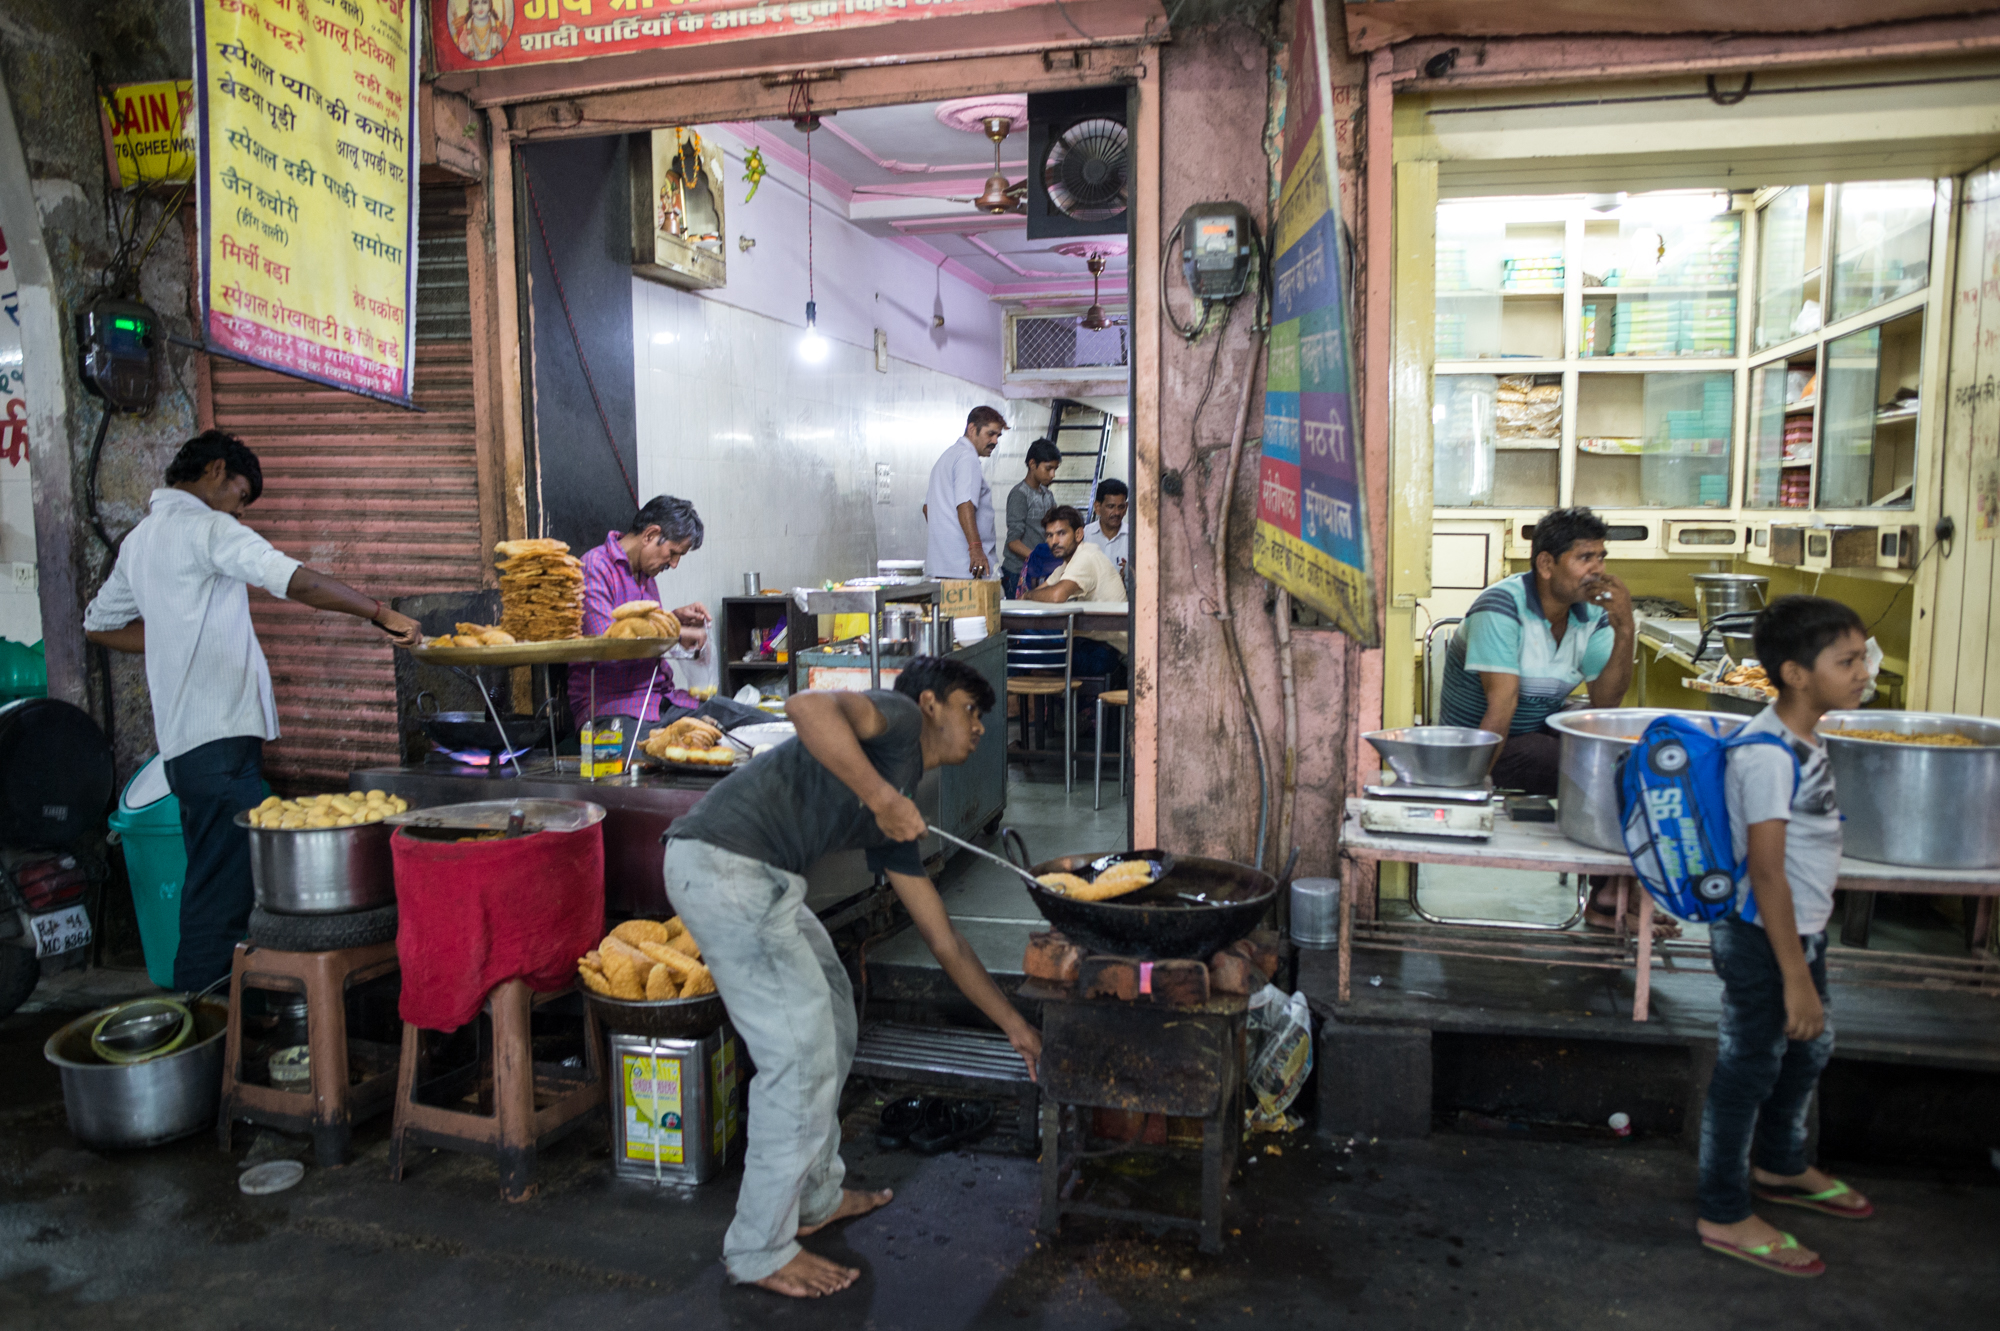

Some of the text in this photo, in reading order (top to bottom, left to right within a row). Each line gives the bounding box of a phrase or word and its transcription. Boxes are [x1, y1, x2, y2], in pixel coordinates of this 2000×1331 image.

[313, 15, 351, 55] आलू
[353, 28, 396, 73] टिकिया
[520, 24, 580, 51] शादी
[583, 10, 676, 44] पार्टियों
[677, 10, 705, 33] के
[789, 1, 838, 25] बुक
[215, 38, 404, 152] स्पेशल प्याज की कचोरी
[354, 70, 382, 95] दही
[111, 93, 171, 138] JAIN
[135, 139, 170, 157] GHEE
[170, 137, 196, 153] WAL
[335, 138, 361, 172] आलू
[388, 162, 404, 183] चाट
[220, 165, 299, 225] जैन कचोरी
[225, 126, 396, 223] स्पेशल दही पपड़ी चाट
[261, 218, 289, 248] वाली)
[351, 230, 403, 266] समोसा
[219, 233, 291, 285] मिर्ची बड़ा
[221, 280, 269, 317] स्पेशल
[272, 297, 340, 341] शेखावाटी
[296, 355, 322, 375] बुक
[324, 345, 356, 369] शादी
[1303, 407, 1346, 463] मठरी
